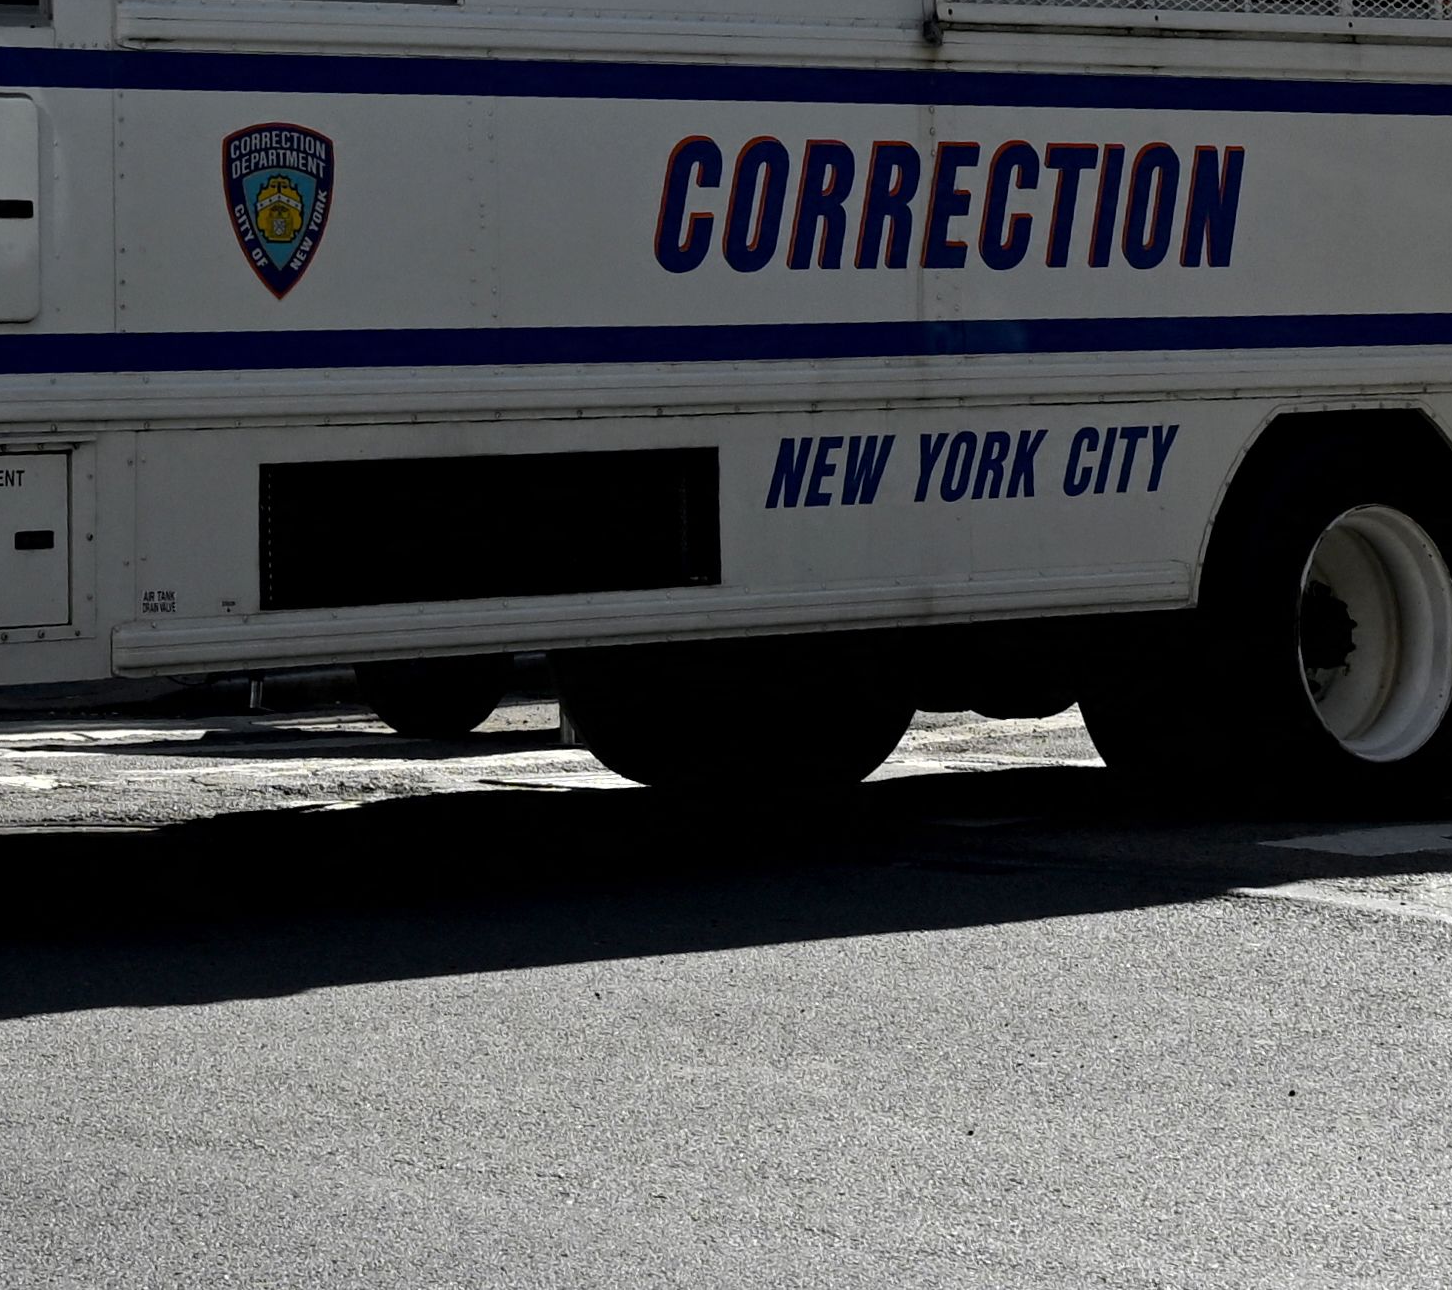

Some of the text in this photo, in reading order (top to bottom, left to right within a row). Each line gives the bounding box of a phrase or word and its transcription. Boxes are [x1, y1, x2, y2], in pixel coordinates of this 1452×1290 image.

[229, 130, 327, 160] CORRECTION
[230, 148, 328, 180] DEPARTMENT
[233, 203, 270, 269] CITY OF
[289, 188, 329, 271] NEW YORK
[654, 135, 1245, 273] CORRECTION
[765, 424, 1180, 509] NEW YORK CITY
